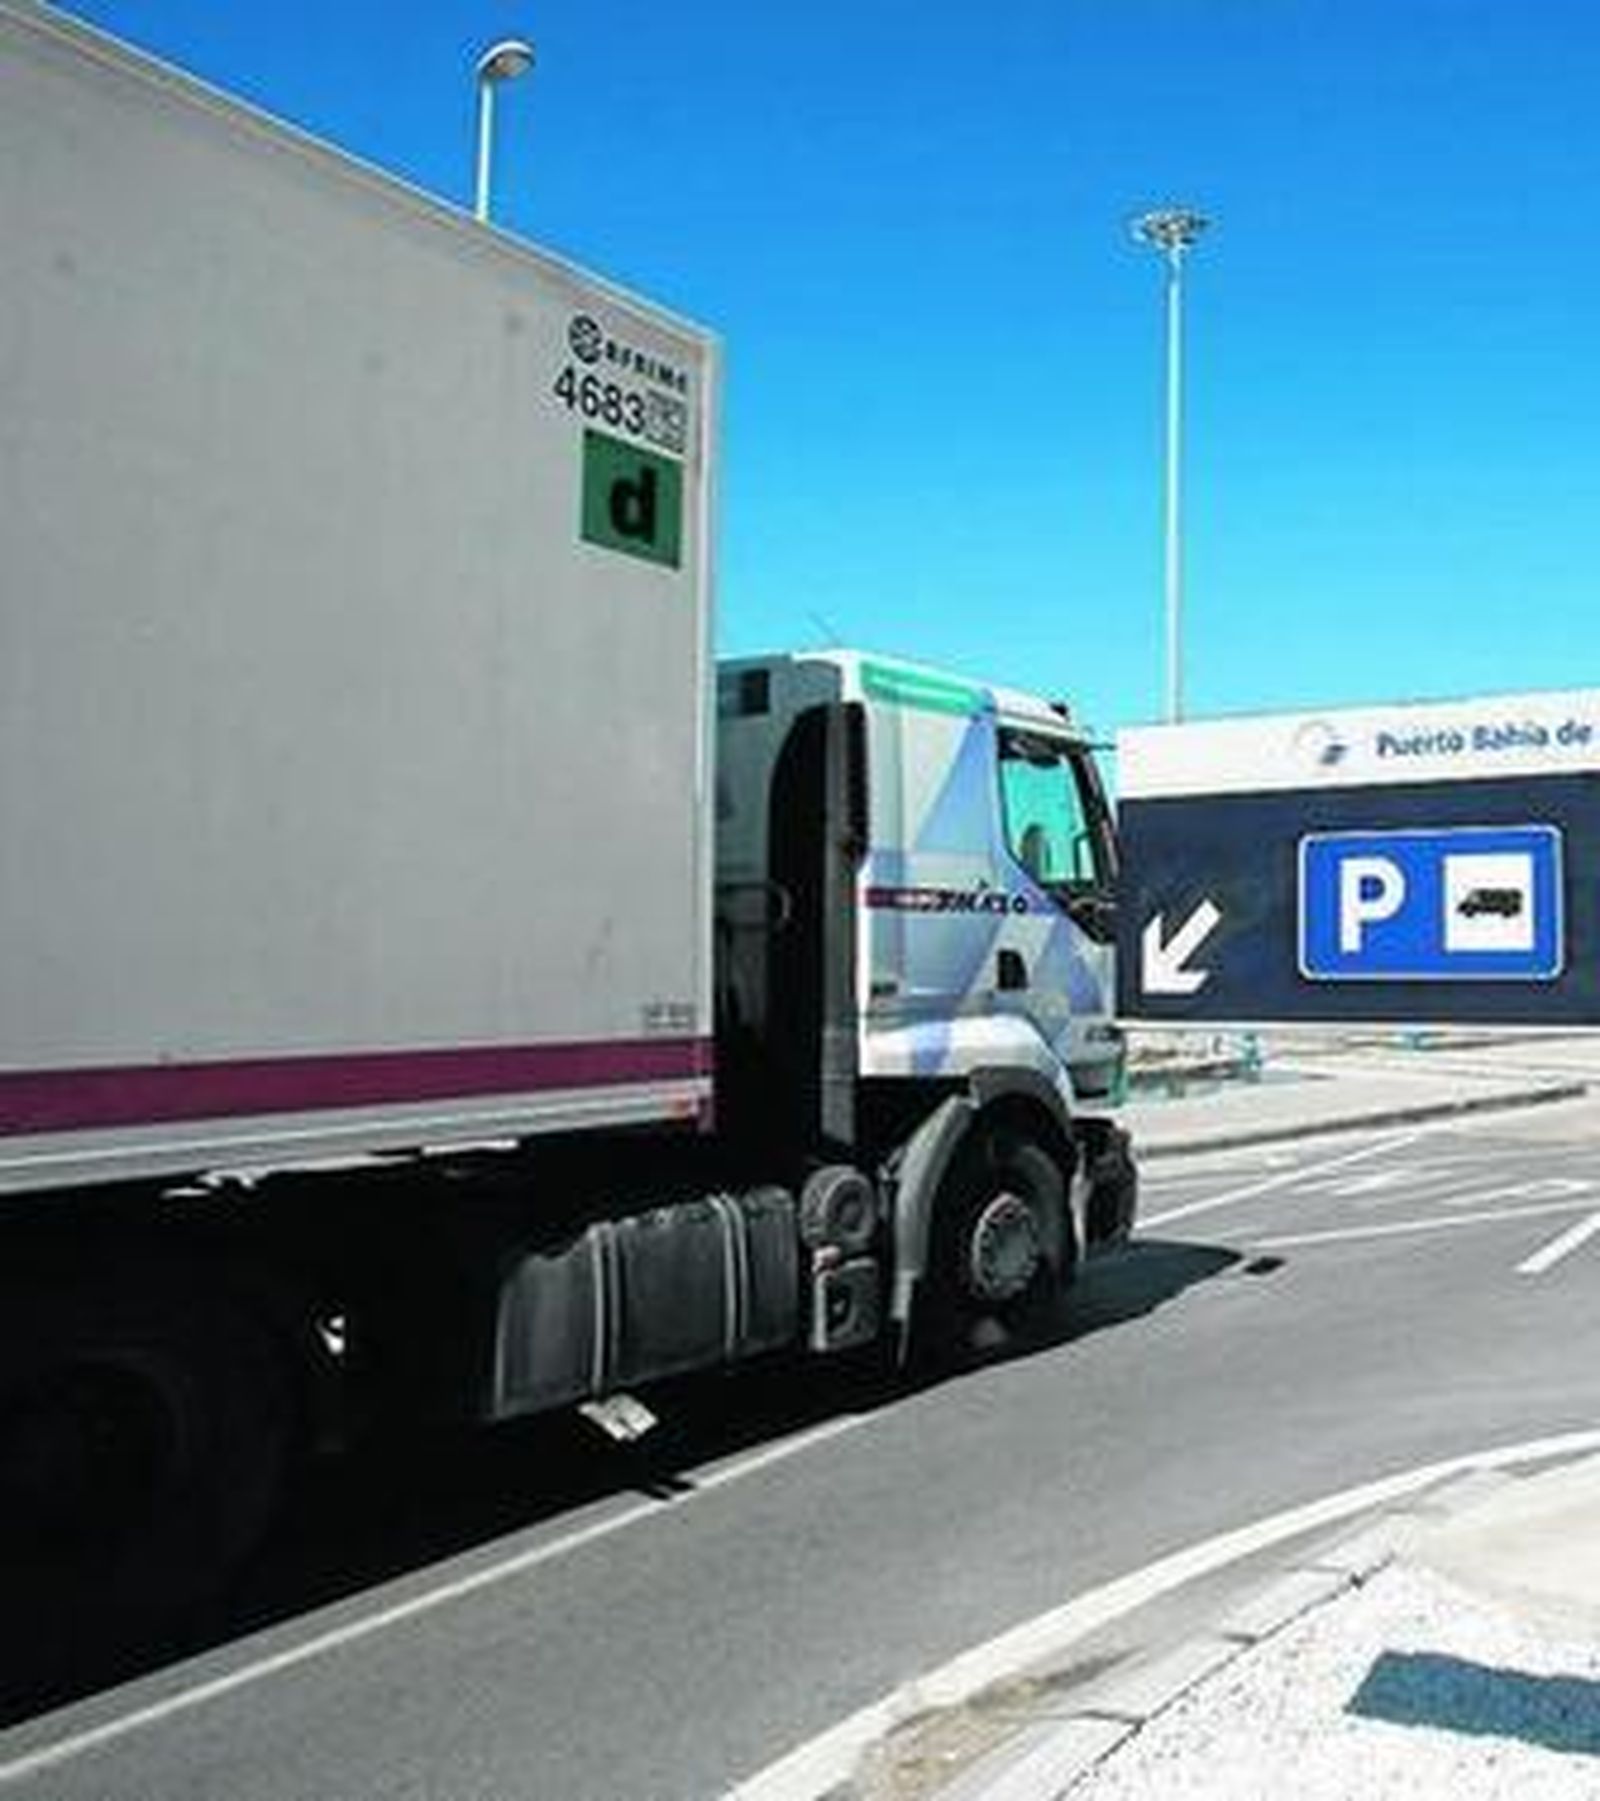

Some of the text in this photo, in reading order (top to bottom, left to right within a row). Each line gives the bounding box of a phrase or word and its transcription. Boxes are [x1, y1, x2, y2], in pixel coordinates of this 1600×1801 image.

[554, 365, 646, 435] 4683
[609, 465, 657, 546] d
[1376, 731, 1464, 758] Puerto
[1556, 719, 1592, 746] de
[1340, 857, 1405, 953] P
